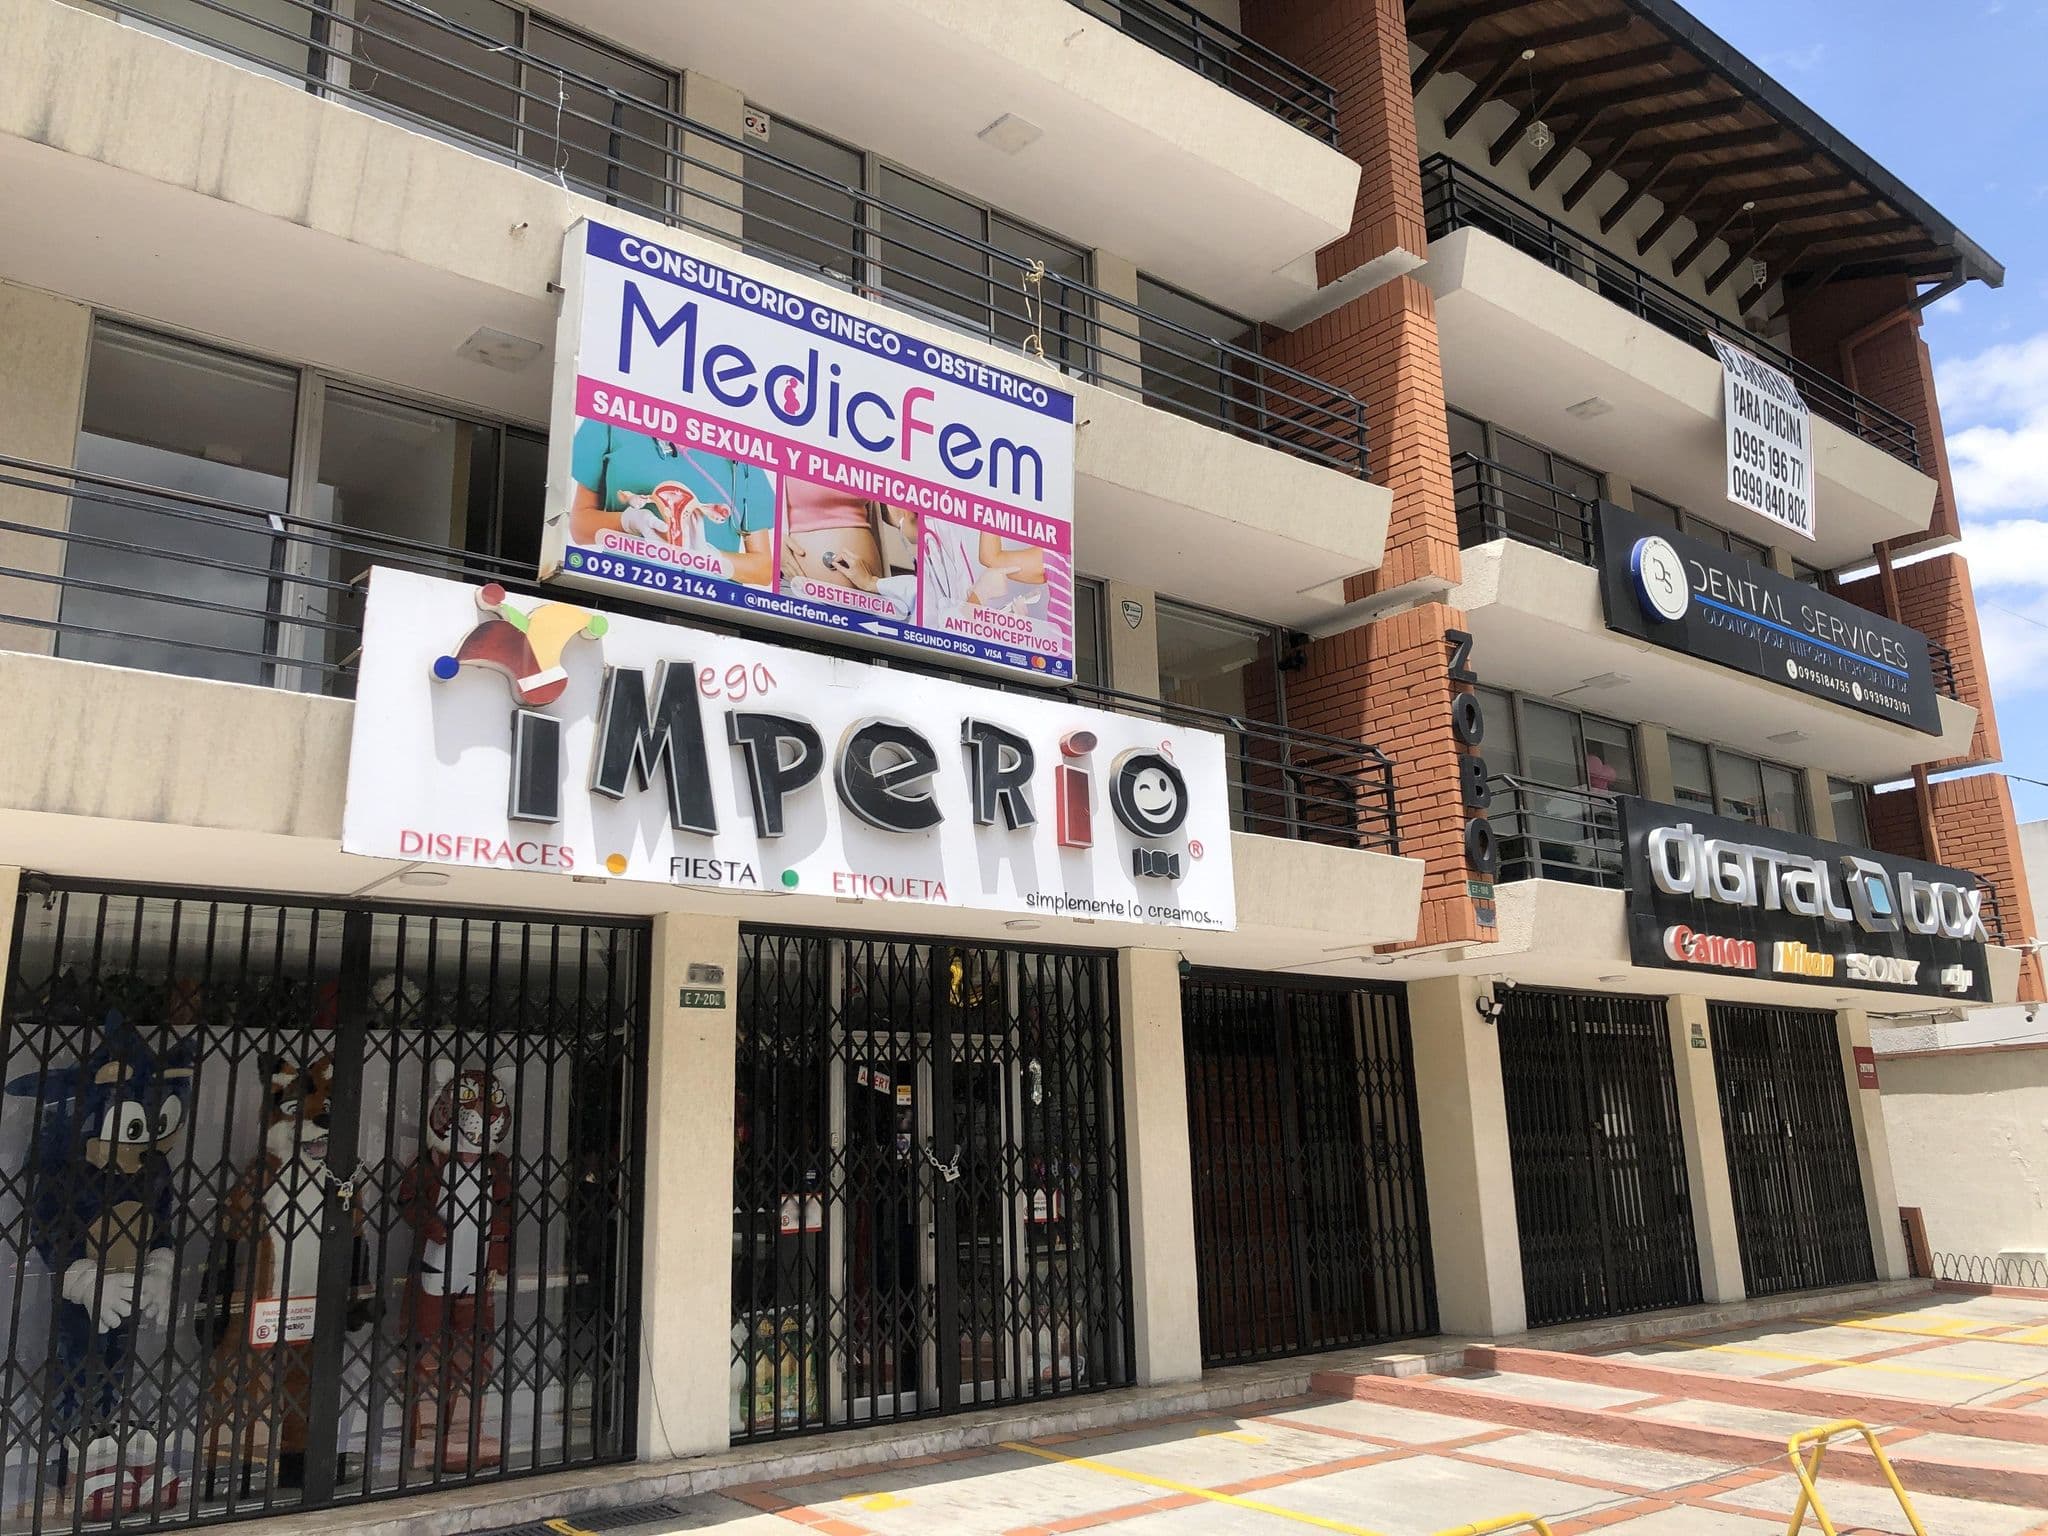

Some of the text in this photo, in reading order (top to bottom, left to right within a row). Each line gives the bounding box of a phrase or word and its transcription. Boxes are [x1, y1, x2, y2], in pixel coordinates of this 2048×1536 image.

[619, 238, 805, 321] CONSULTORIO
[811, 307, 901, 356] GINECO
[923, 348, 1048, 408] OBSTÉTRICO
[618, 280, 1043, 502] Medicfem
[1713, 339, 1808, 416] SE ARRIENDA
[1733, 382, 1802, 450] PARA OFICINA
[592, 390, 1057, 545] SALUD SEXUAL Y PLANIFICACIÓN FAMILIAR
[1733, 427, 1805, 492] 0995 196 771
[1733, 465, 1807, 530] 0999 840 802
[604, 534, 722, 575] GINECOLOGÍA
[587, 557, 625, 578] 098
[631, 567, 667, 587] 720
[672, 576, 717, 599] 2144
[744, 592, 849, 627] @medicfem.ec
[804, 582, 895, 615] OBSTETRICIA
[973, 607, 1033, 633] MÉTODOS
[1690, 559, 1791, 626] DENTAL
[1800, 604, 1909, 670] SERVICES
[904, 630, 951, 649] SEGUNDO
[953, 641, 976, 654] PISO
[984, 648, 1002, 660] VISA
[945, 617, 1058, 653] ANTICONCEPTIVOS
[1798, 666, 1850, 694] 0995184755
[1445, 628, 1497, 874] ZOBO
[400, 829, 948, 902] DISFRACES FIESTA ETIQUETA
[1026, 891, 1223, 926] simplemente lo creamos...
[1898, 871, 1989, 943] box
[1664, 924, 1757, 970] Canon
[1773, 940, 1834, 978] Nikon
[1846, 952, 1920, 986] SONY
